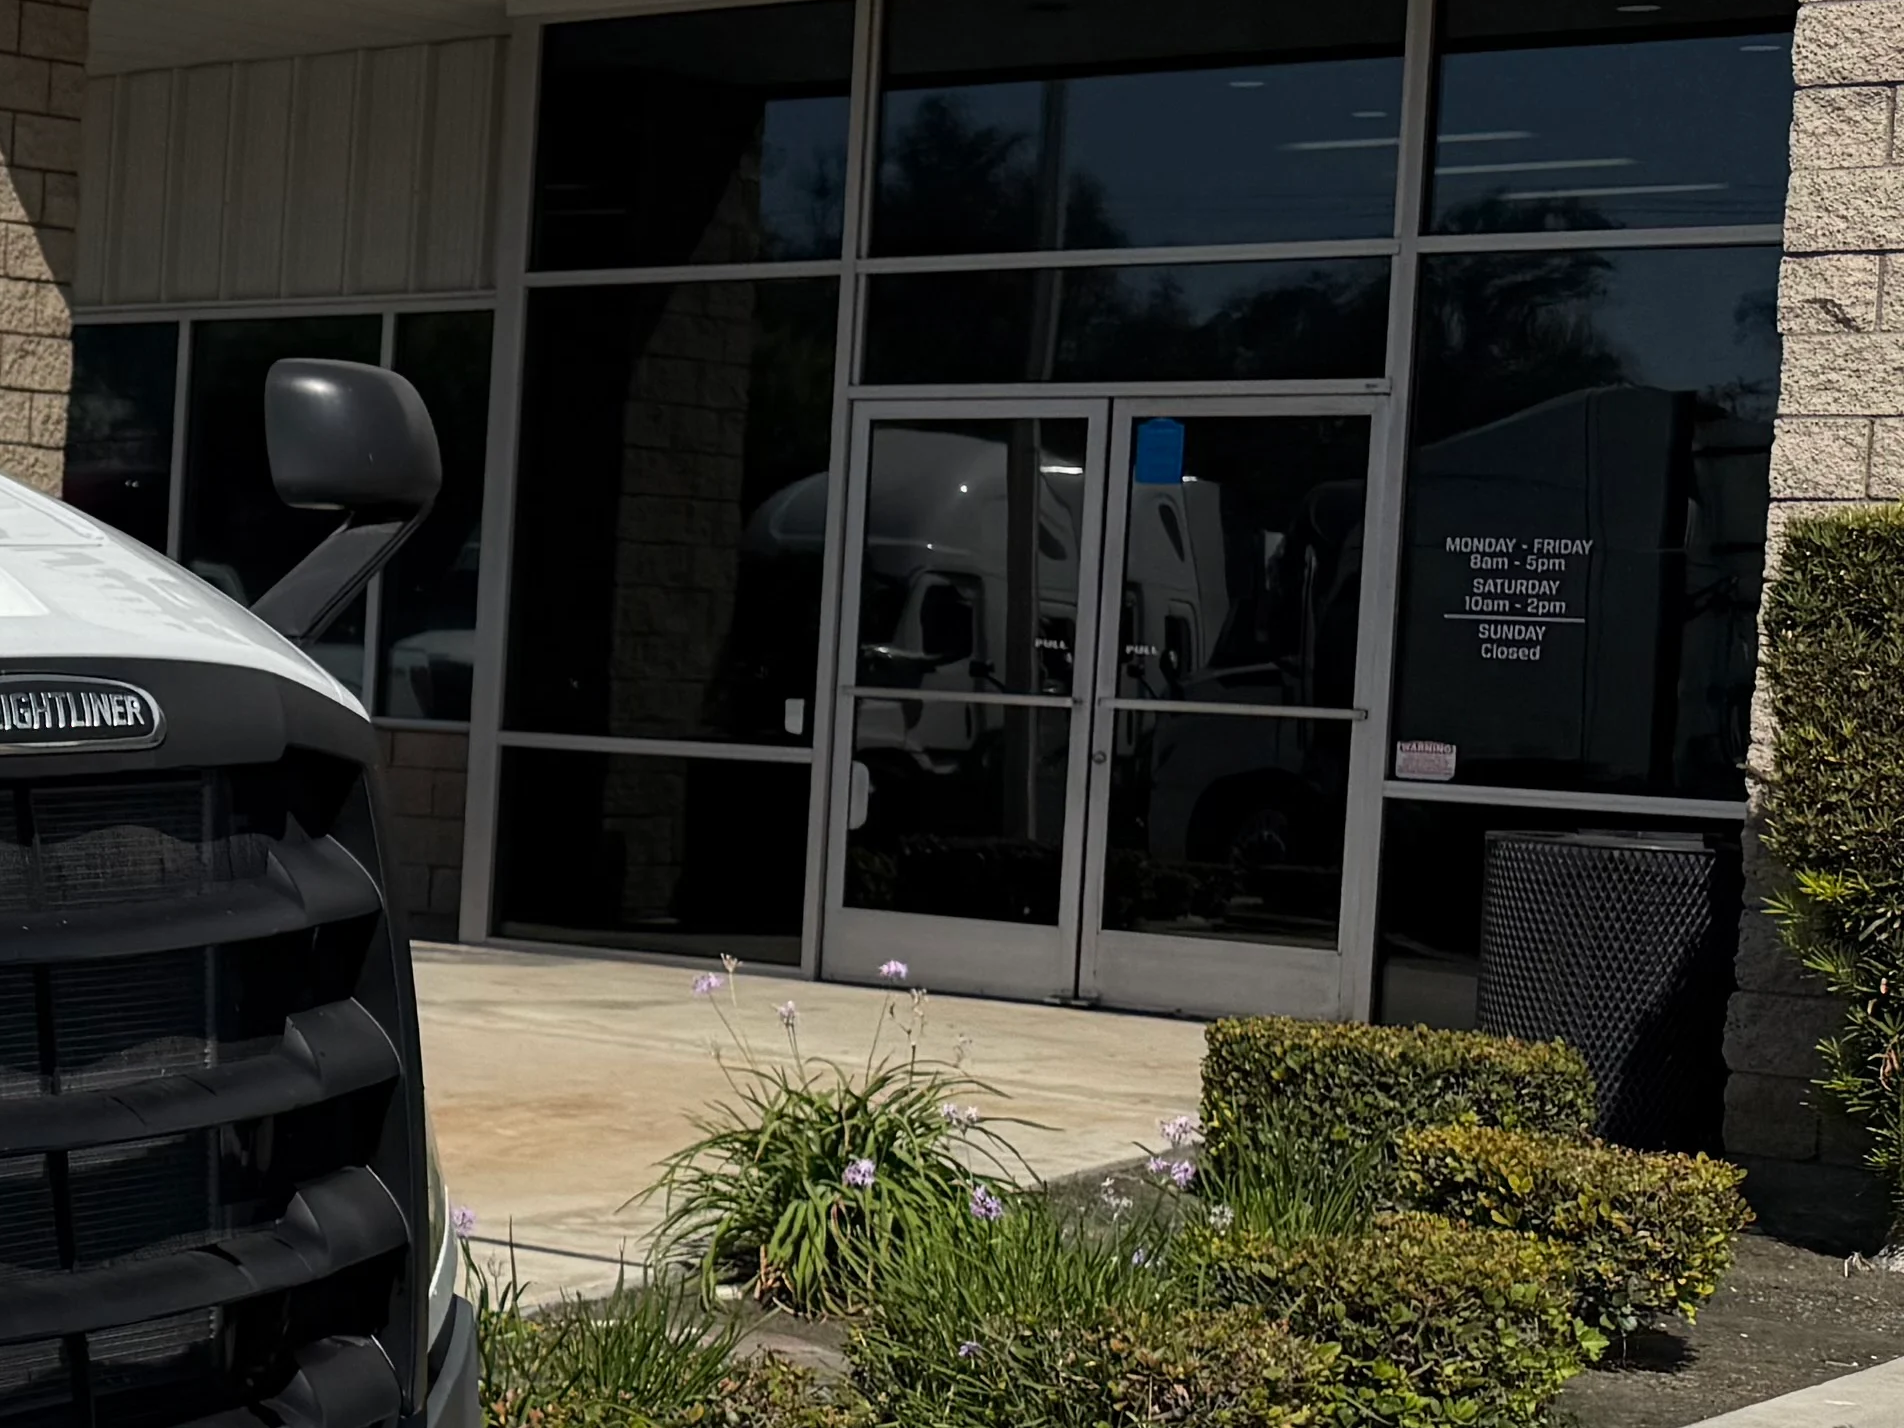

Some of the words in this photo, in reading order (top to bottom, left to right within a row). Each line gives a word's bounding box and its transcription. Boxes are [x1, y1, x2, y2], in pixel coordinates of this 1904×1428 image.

[1446, 537, 1516, 554] MONDAY
[1533, 539, 1593, 555] FRIDAY
[1470, 554, 1509, 570] 8am
[1525, 556, 1566, 573] 5pm
[1473, 578, 1560, 595] SATURDAY
[1464, 596, 1509, 612] 10am
[1527, 598, 1566, 615] 2pm
[1478, 624, 1546, 641] SUNDAY
[1481, 643, 1541, 661] Closed
[1401, 741, 1452, 754] WARNING
